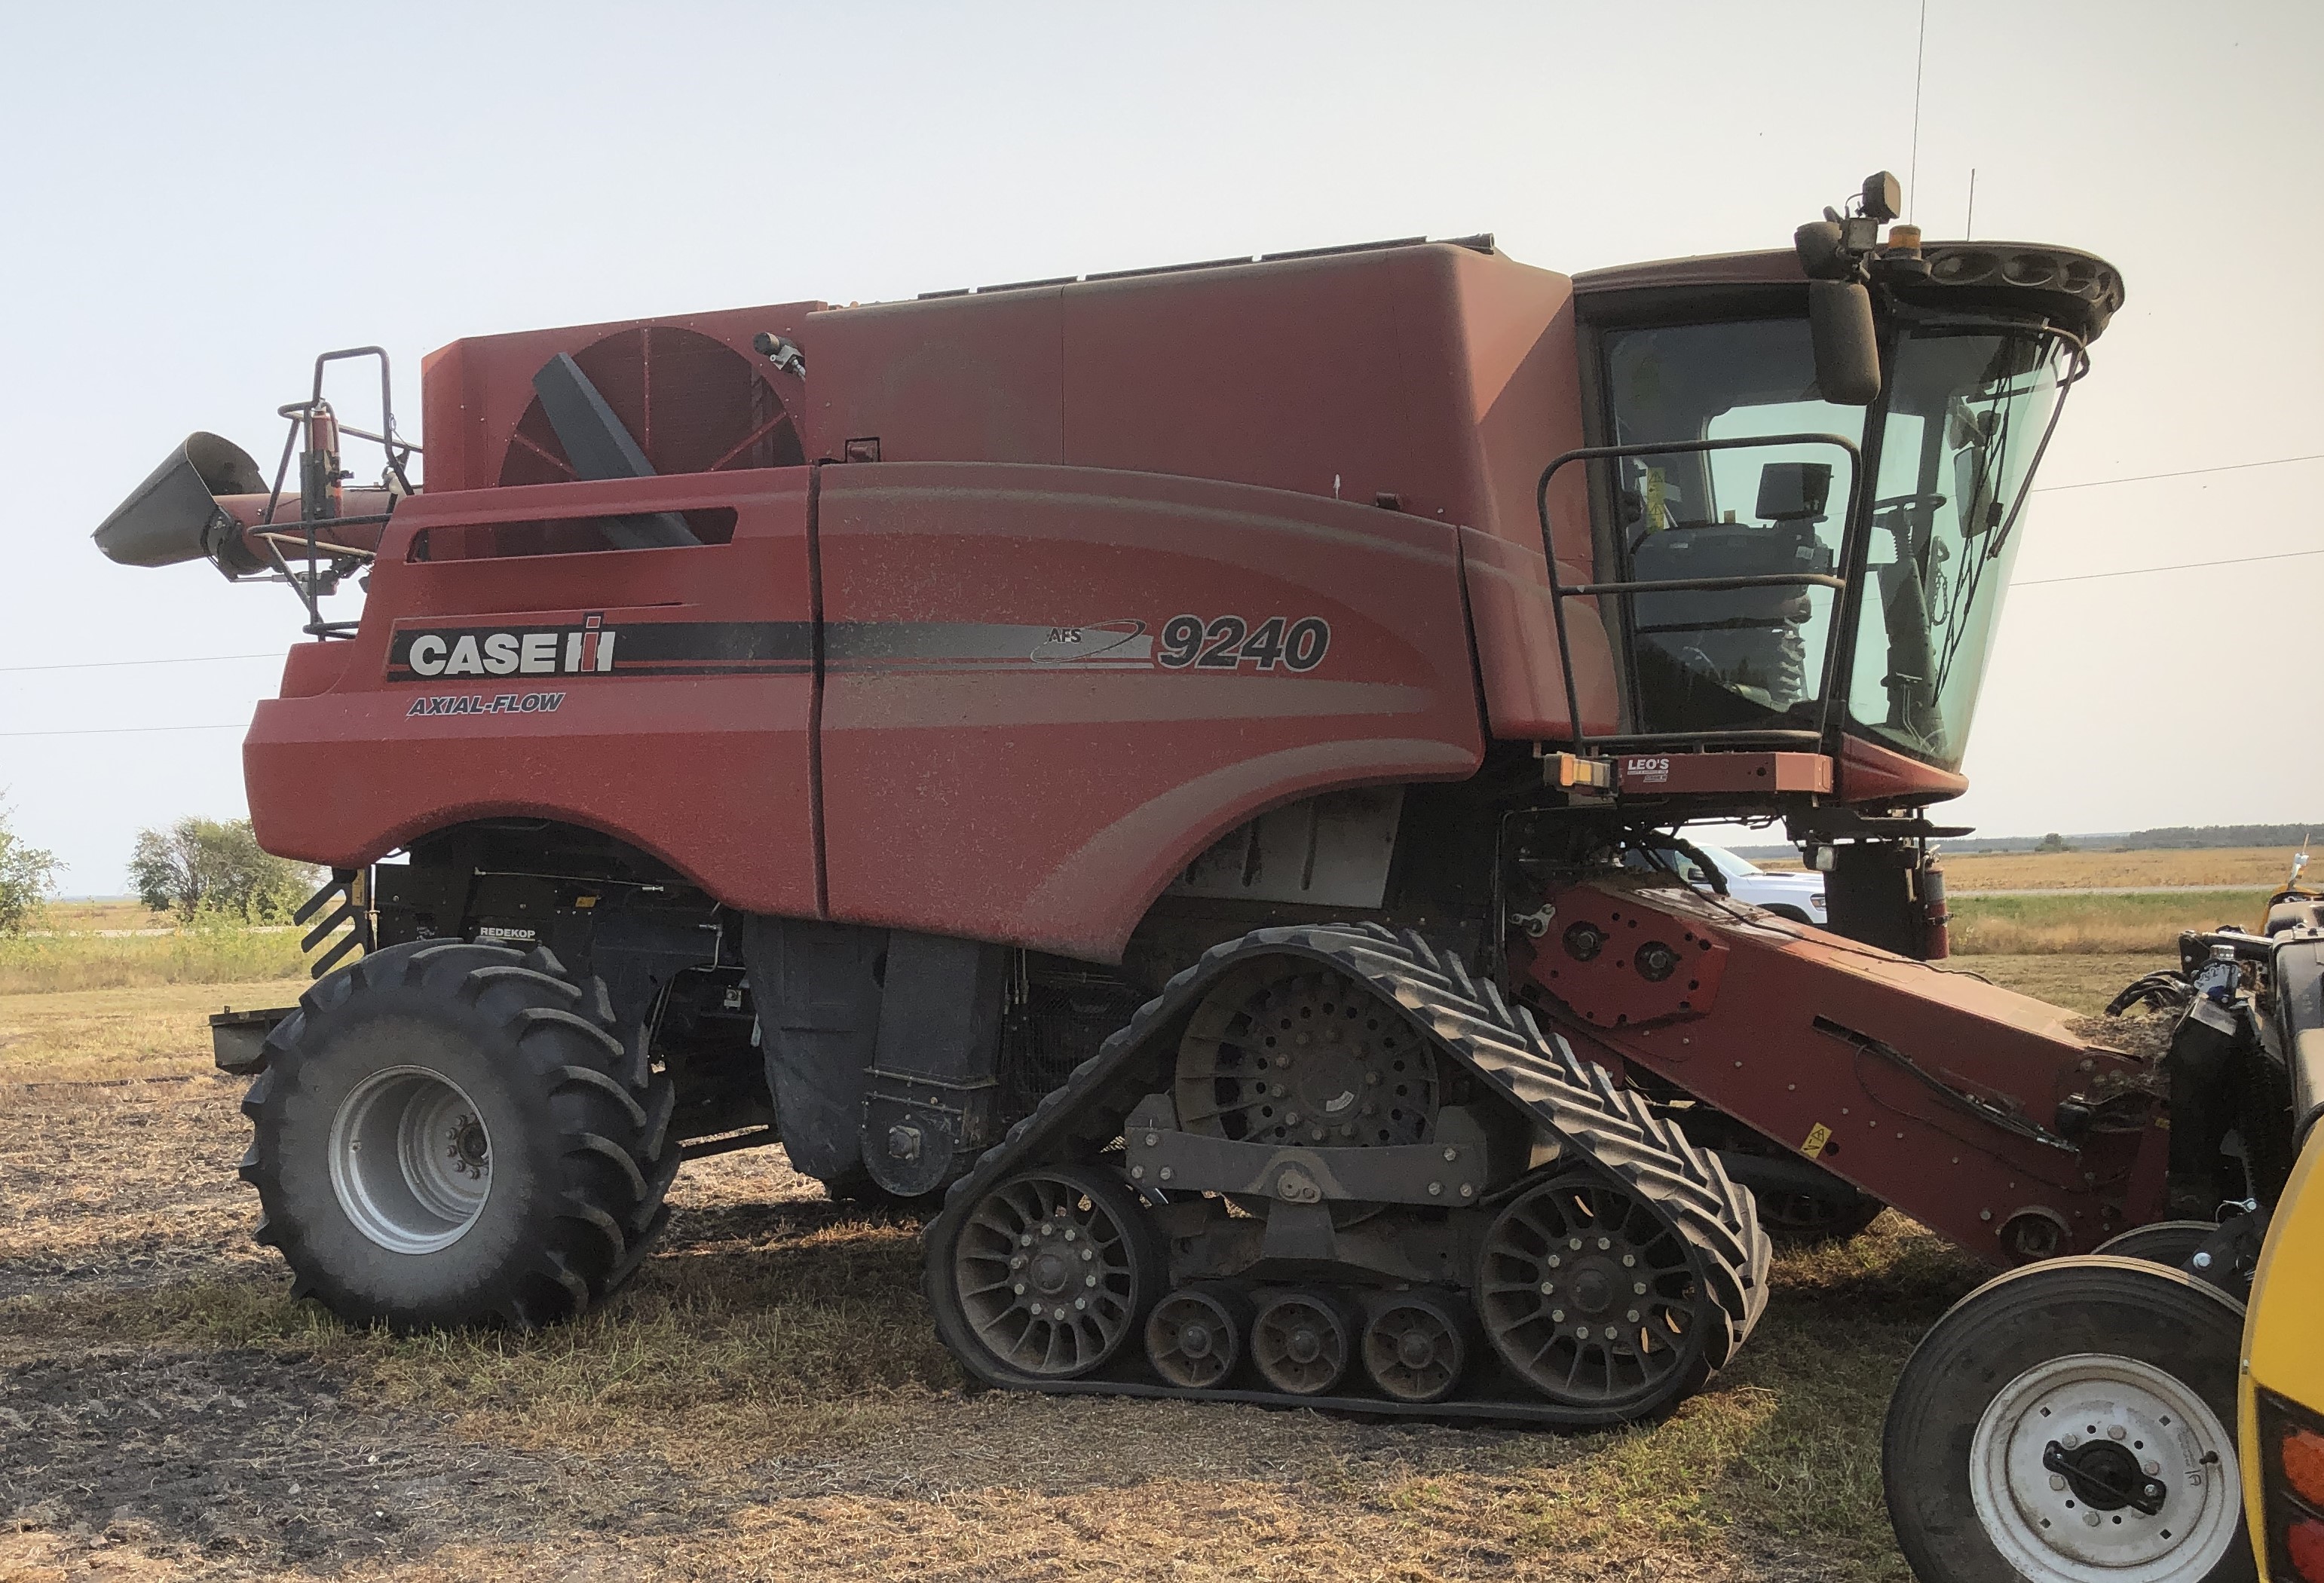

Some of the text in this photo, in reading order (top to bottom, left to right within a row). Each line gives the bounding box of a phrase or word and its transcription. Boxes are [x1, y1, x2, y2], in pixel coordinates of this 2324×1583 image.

[1048, 627, 1082, 644] AFS
[1158, 614, 1331, 672] 9240
[409, 633, 558, 675] CASE
[406, 692, 565, 717] AXIAL-FLOW
[1627, 758, 1670, 770] LEO'S
[480, 927, 536, 938] REDEKOP
